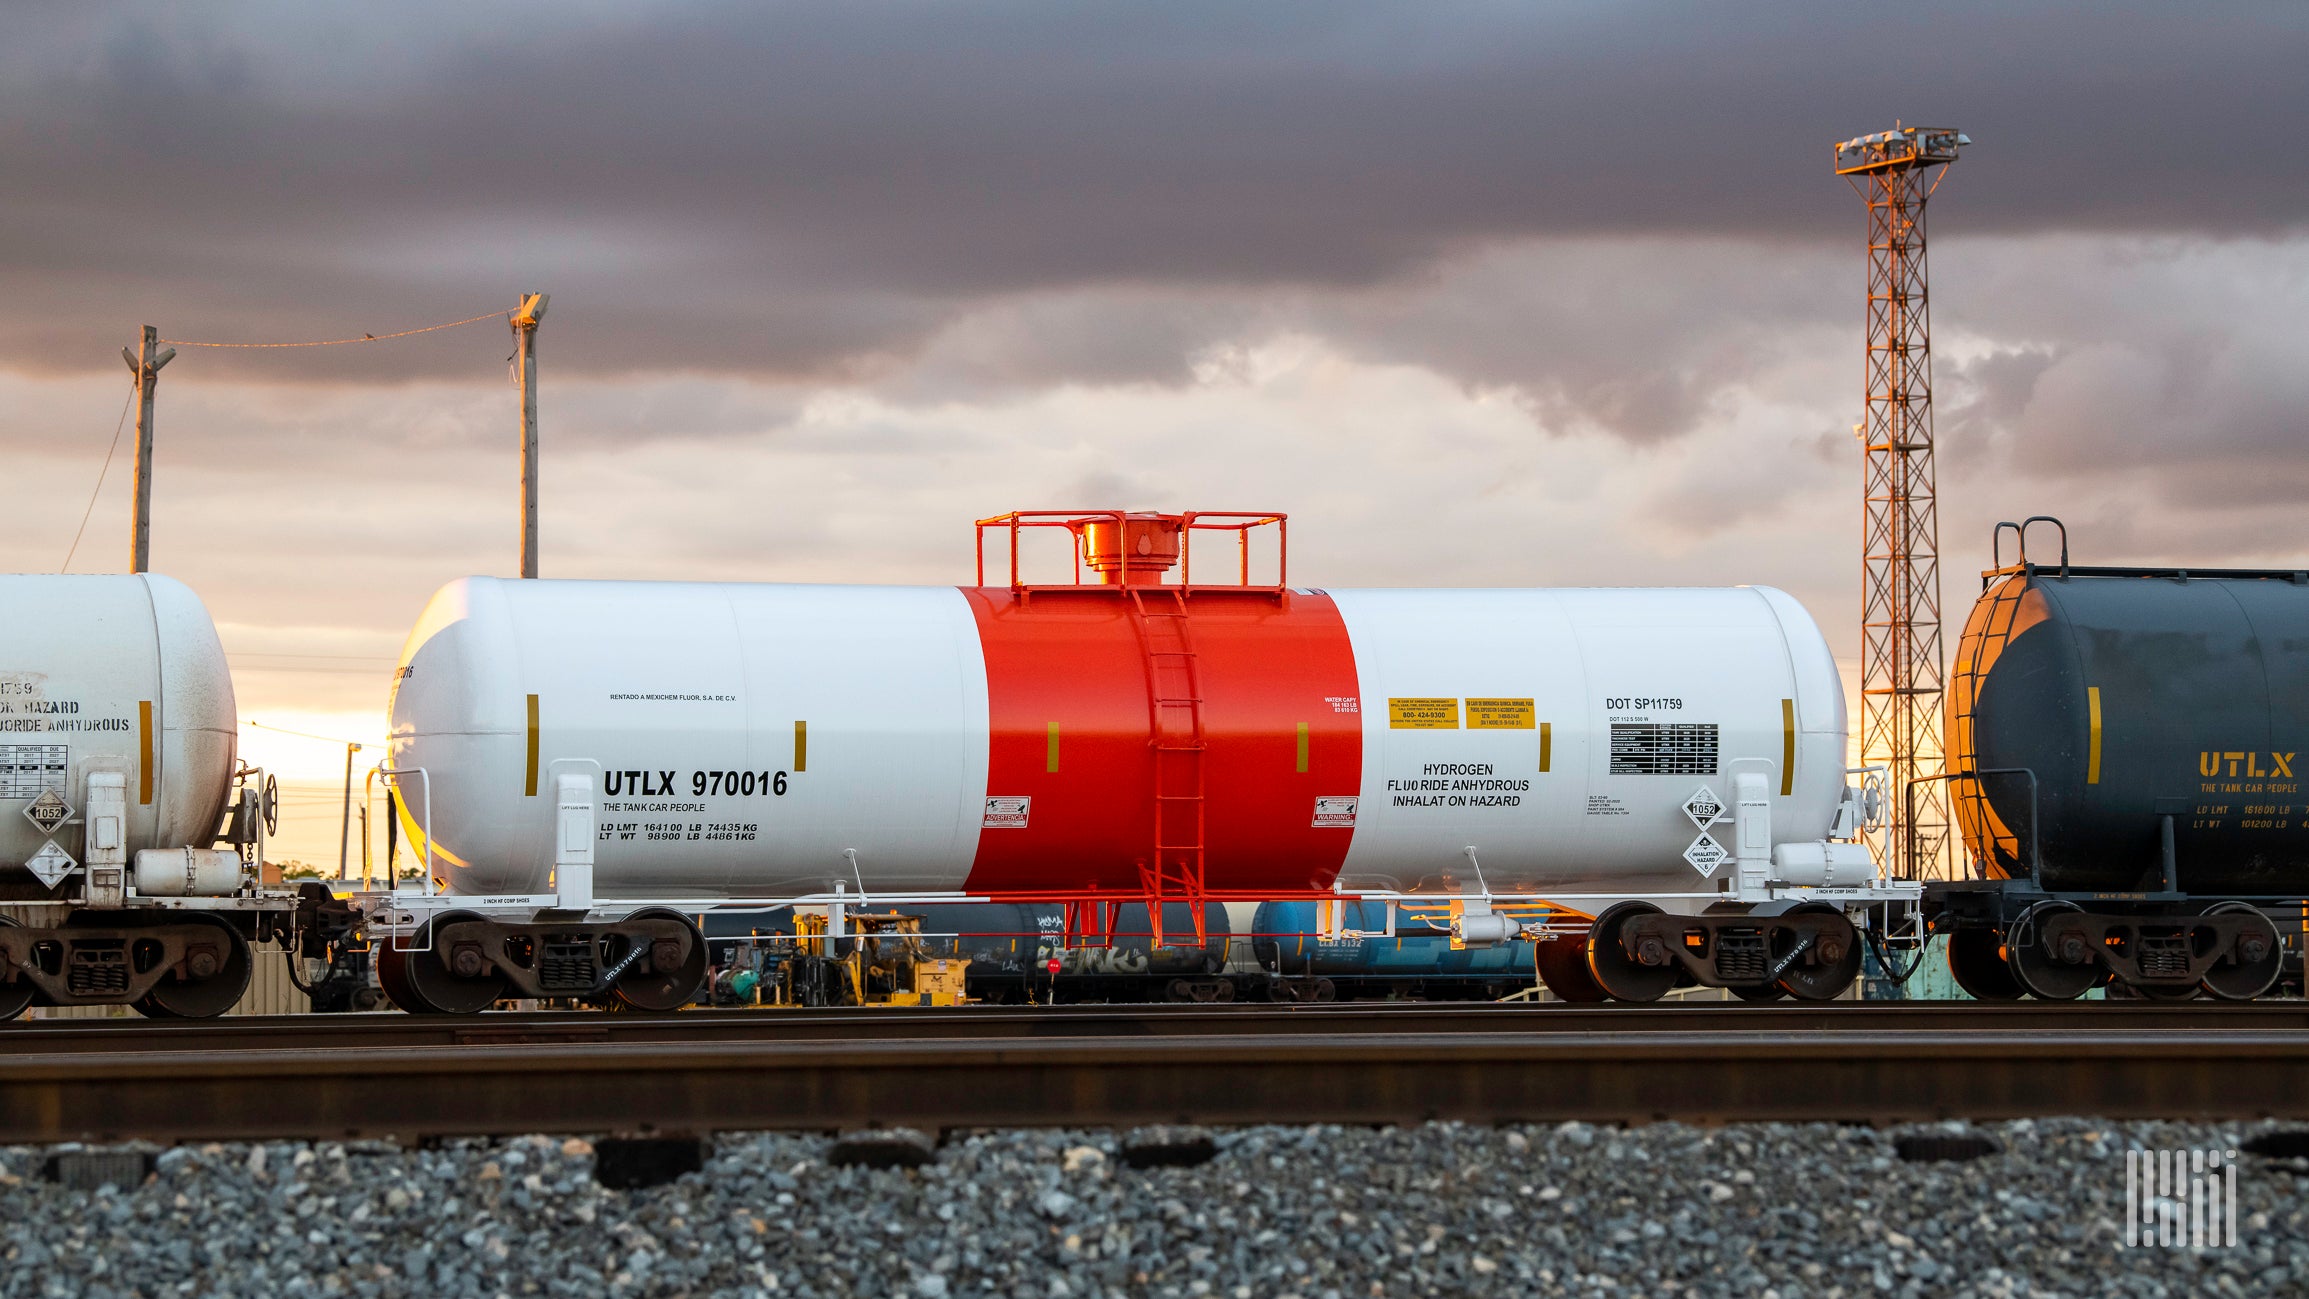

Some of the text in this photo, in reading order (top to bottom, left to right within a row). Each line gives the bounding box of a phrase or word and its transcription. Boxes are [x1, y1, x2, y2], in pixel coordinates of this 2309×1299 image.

[1606, 698, 1682, 710] DOT SP11759
[48, 718, 130, 732] ANHYDROUS
[1424, 764, 1493, 776] HYDROGEN
[2200, 752, 2296, 778] UTLX
[604, 770, 788, 796] UTLX 970016
[1452, 780, 1530, 792] ANHYDROUS
[2201, 784, 2298, 792] THE TANK CAR PEOPLE
[1470, 796, 1520, 806] HAZARD
[603, 802, 706, 812] THE TANK CAR PEOPLE
[1693, 804, 1715, 814] 1052
[2196, 806, 2208, 814] LD
[2211, 806, 2228, 814] LMT
[2280, 806, 2290, 814] LB
[36, 808, 60, 818] 1052
[644, 824, 682, 832] 164100
[708, 824, 740, 832] 74435
[742, 824, 758, 832] KG
[2193, 820, 2204, 828] LT
[2209, 820, 2221, 828] WT
[2242, 820, 2272, 828] 101200
[2275, 820, 2287, 828] LB
[647, 832, 680, 840] 98900
[686, 832, 700, 840] LB
[605, 966, 621, 980] UTLX
